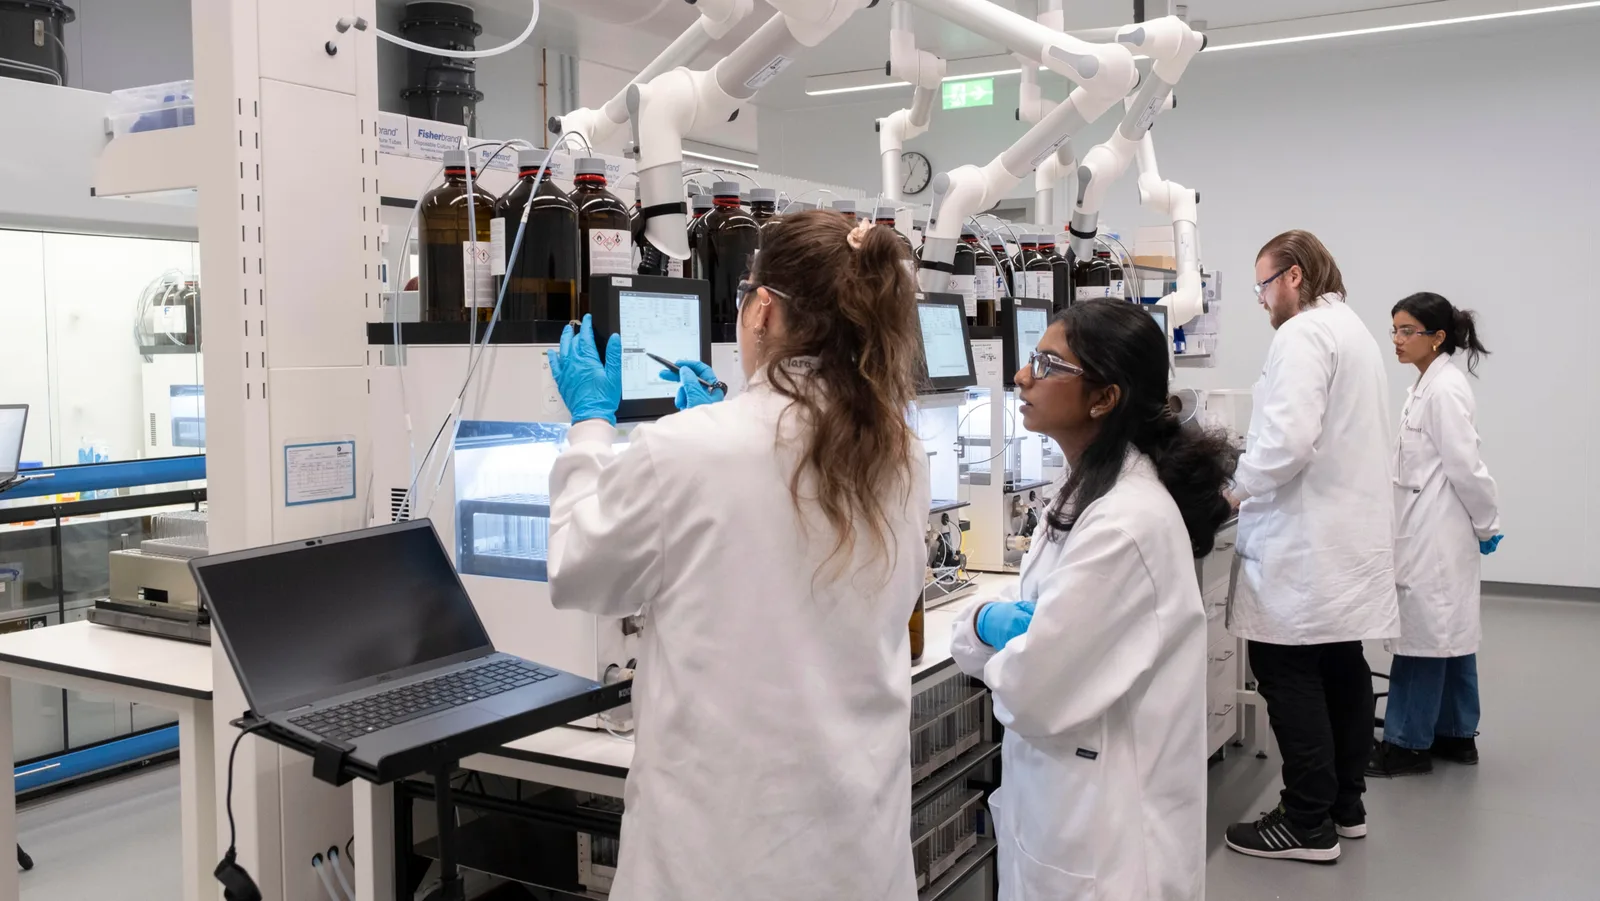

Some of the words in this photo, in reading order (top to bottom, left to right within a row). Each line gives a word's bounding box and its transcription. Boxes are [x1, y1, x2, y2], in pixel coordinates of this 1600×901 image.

[379, 127, 397, 136] rand
[418, 129, 460, 143] Fisherbrand
[785, 357, 812, 368] lara
